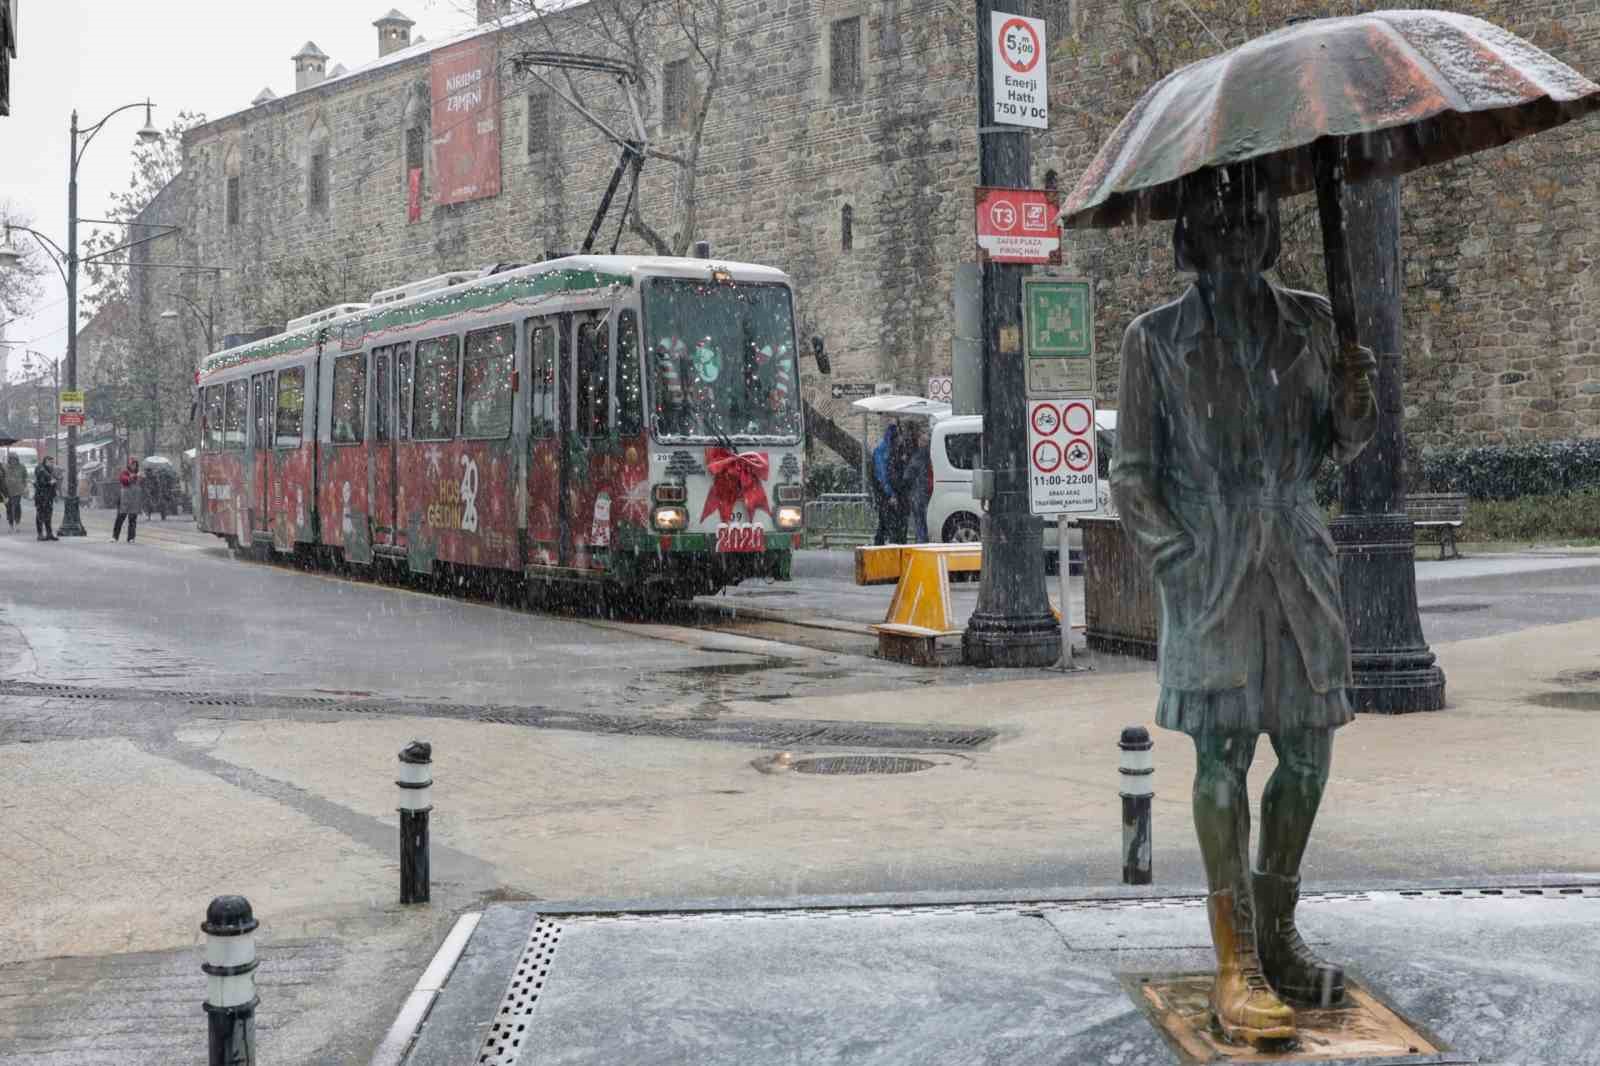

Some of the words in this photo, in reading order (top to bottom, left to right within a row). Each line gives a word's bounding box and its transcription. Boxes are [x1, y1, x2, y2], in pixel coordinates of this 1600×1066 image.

[1004, 76, 1037, 91] Enerji
[997, 102, 1017, 115] 750
[1020, 105, 1028, 117] V
[1031, 108, 1046, 119] DC
[994, 207, 1014, 224] T3
[1034, 474, 1093, 486] 11:00-22:00
